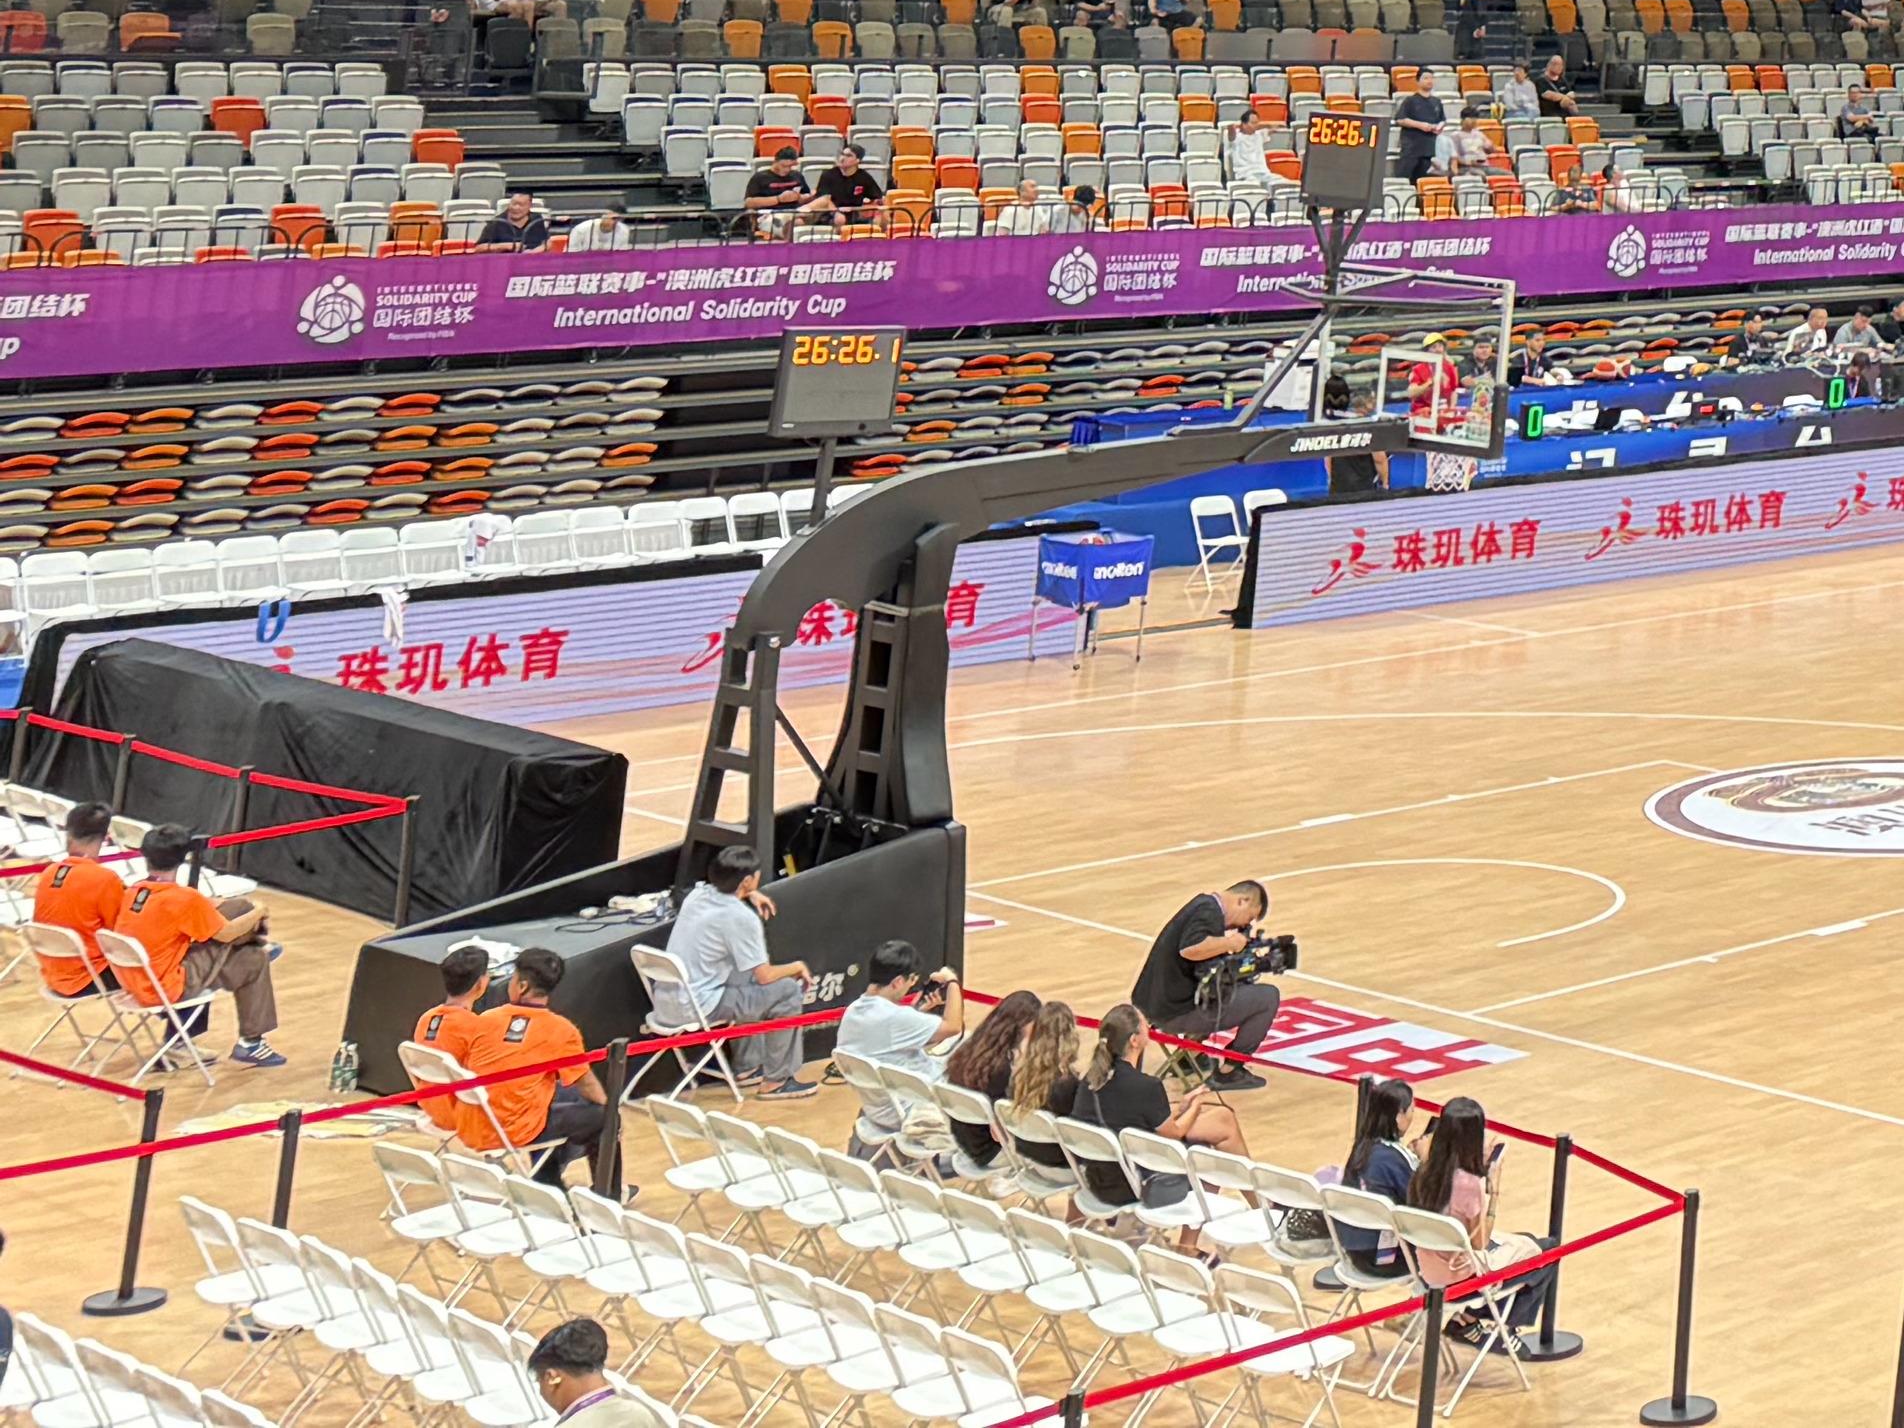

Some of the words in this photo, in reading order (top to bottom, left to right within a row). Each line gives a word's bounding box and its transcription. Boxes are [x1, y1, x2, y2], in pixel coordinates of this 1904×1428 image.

[1753, 246, 1835, 266] International
[1838, 240, 1896, 263] Solidarity
[0, 293, 88, 320] 团结杯
[376, 291, 448, 307] SOLIDARITY
[453, 290, 477, 303] CUP
[553, 294, 694, 329] International
[700, 286, 800, 321] Solidarity
[806, 293, 847, 319] Cup
[373, 305, 475, 329] 国际团结杯
[1656, 489, 1788, 541] 珠玑体育
[1392, 517, 1541, 572] 珠玑体育
[1094, 561, 1146, 581] molten
[336, 626, 569, 697] 珠玑体育
